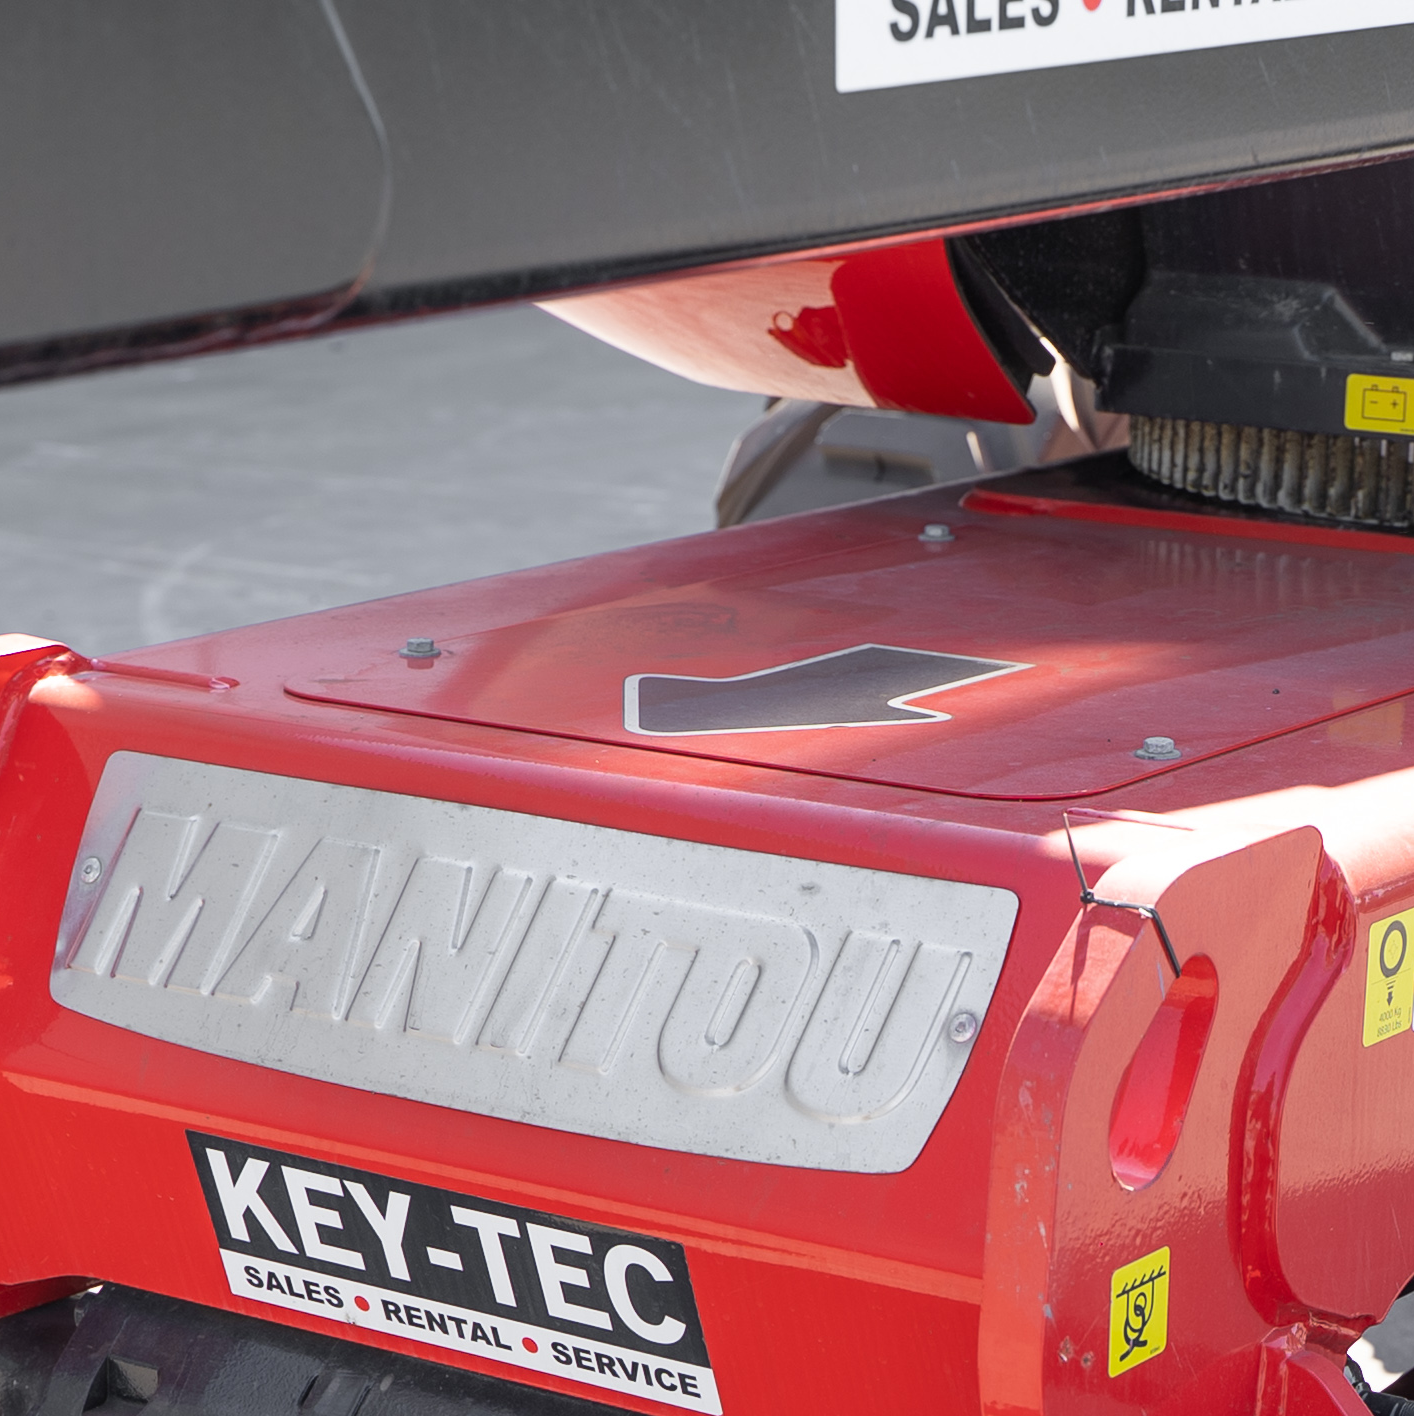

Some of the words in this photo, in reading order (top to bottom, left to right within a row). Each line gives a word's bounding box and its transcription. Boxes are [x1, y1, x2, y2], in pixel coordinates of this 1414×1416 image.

[67, 804, 973, 1121] MANITOU
[204, 1147, 687, 1345] KEY-TEC
[243, 1264, 344, 1309] SALES
[382, 1299, 514, 1351] RENTAL
[551, 1341, 703, 1399] SERVICE
